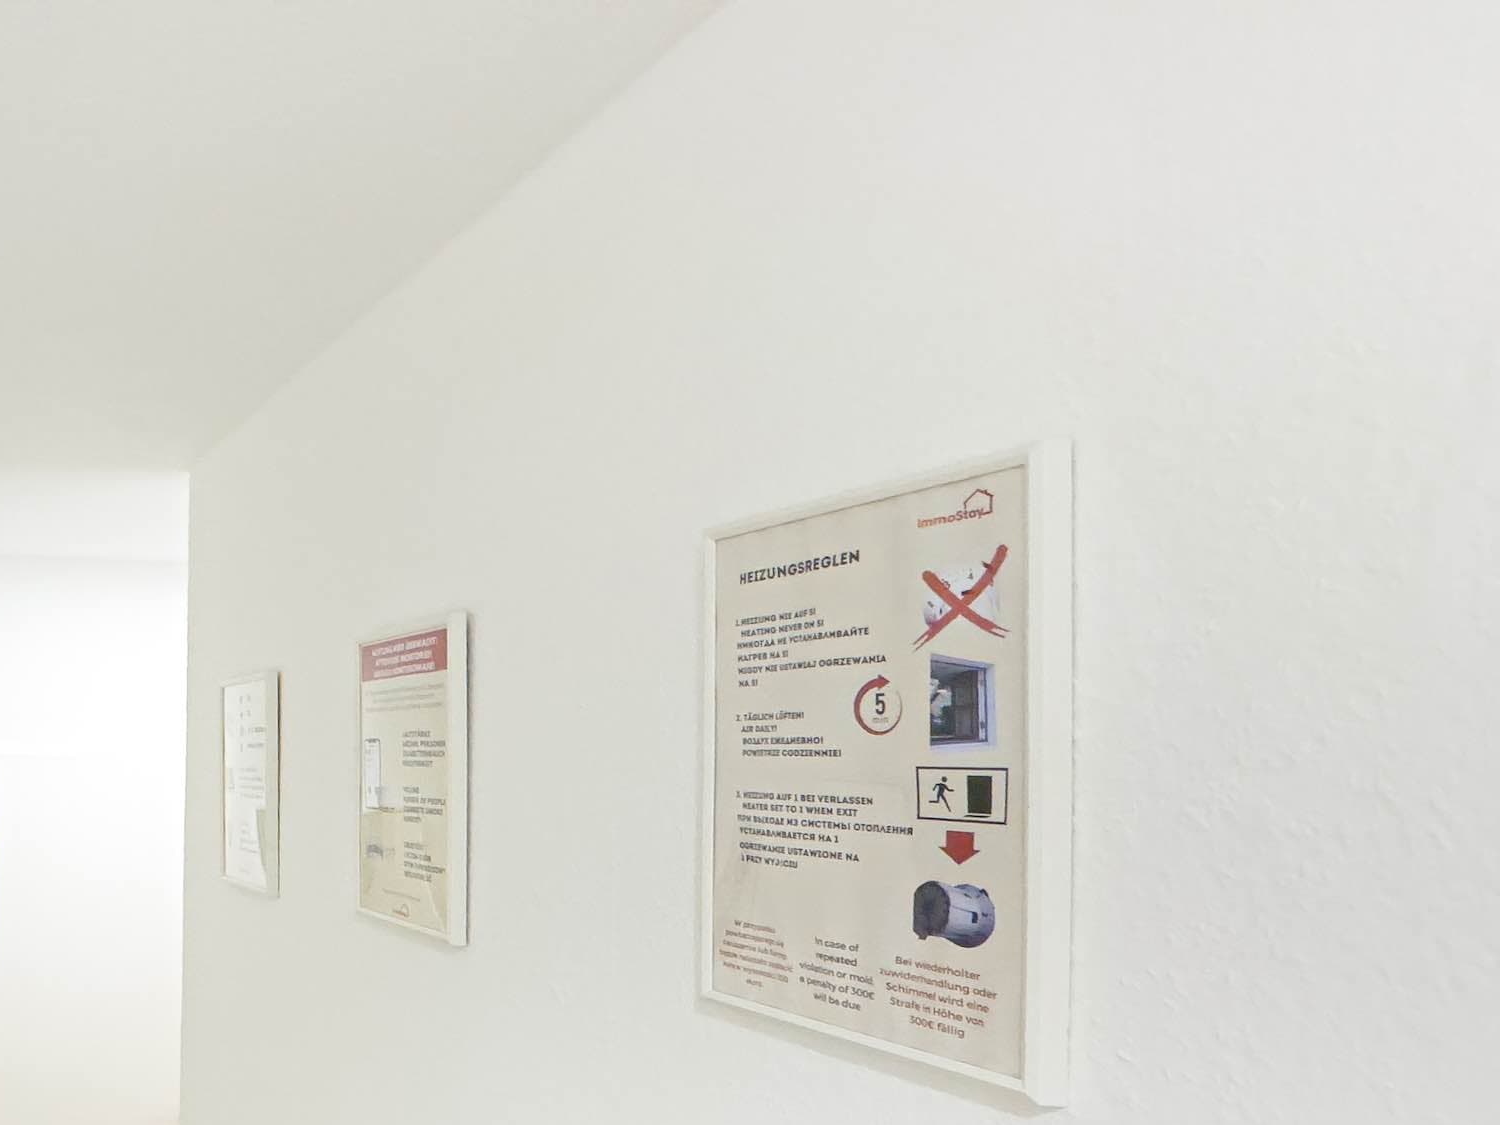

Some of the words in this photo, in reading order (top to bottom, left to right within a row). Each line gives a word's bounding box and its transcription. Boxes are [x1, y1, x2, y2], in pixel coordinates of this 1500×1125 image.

[740, 550, 860, 584] HEIZUNGSREGLEN
[779, 612, 792, 620] NIE
[794, 609, 808, 618] AUF
[741, 626, 776, 637] HEATING
[779, 623, 802, 633] NEVER
[804, 621, 815, 629] ON
[765, 664, 778, 672] NIE
[818, 655, 887, 667] OGRZEWANIA
[875, 693, 885, 715] 5
[782, 749, 842, 757] CODZIENNIE!
[800, 794, 815, 802] BEI
[817, 795, 873, 805] VERLASSEN
[742, 802, 769, 811] HEATER
[770, 804, 784, 812] SET
[786, 805, 797, 813] TO
[805, 806, 833, 815] WHEN
[836, 808, 858, 817] EXIT
[800, 820, 851, 830] СИСТЕМЫ
[853, 823, 913, 836] ОТОПЛЕНИЯ
[818, 834, 832, 843] НА
[788, 847, 843, 860] USTAWIONE
[845, 853, 860, 862] NA
[814, 936, 823, 946] In
[824, 940, 847, 950] case
[848, 944, 859, 952] of
[816, 952, 858, 967] repeated
[895, 956, 912, 966] Bei
[915, 961, 980, 981] wiederholter
[807, 977, 836, 992] penalty
[851, 986, 875, 1000] 300€
[973, 987, 998, 1000] oder
[813, 993, 827, 1002] will
[828, 996, 840, 1006] be
[841, 1000, 861, 1011] due
[886, 982, 936, 1000] Schimmel
[938, 995, 964, 1008] wird
[966, 1001, 990, 1013] eine
[890, 996, 920, 1012] Strafe
[922, 1005, 931, 1014] in
[933, 1007, 963, 1022] Höhe
[966, 1015, 985, 1026] von
[909, 1015, 934, 1030] 300€
[937, 1022, 965, 1039] fällig
